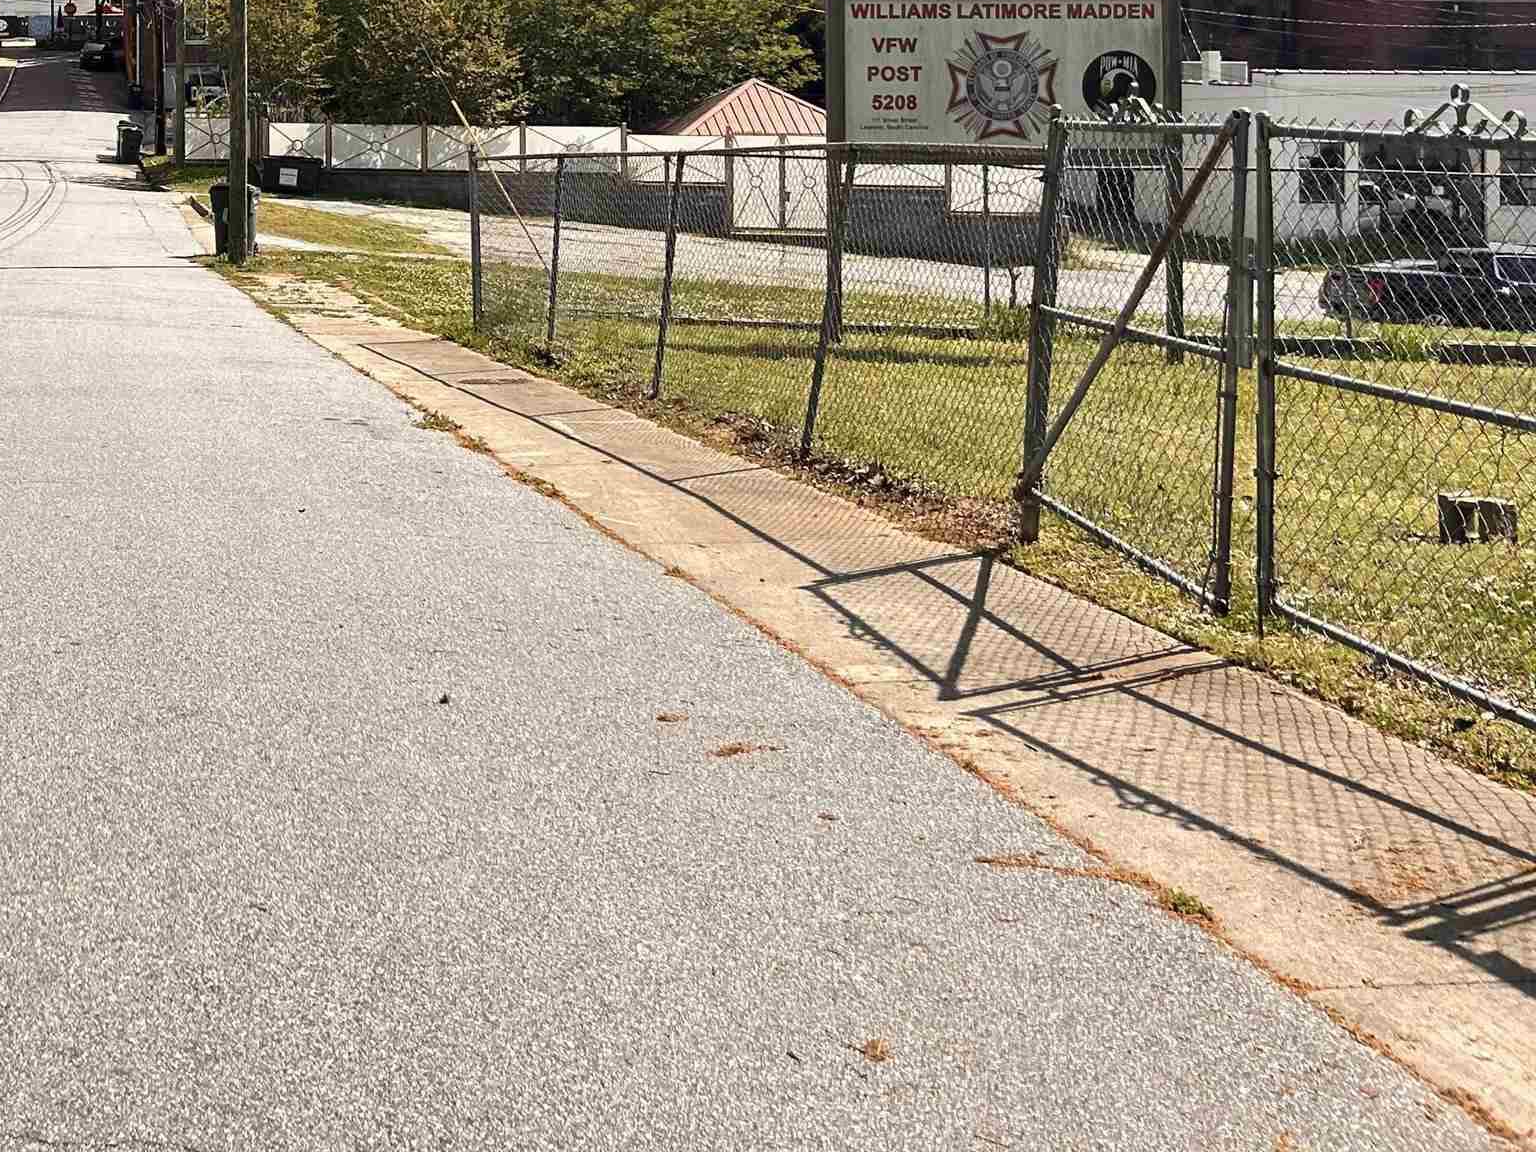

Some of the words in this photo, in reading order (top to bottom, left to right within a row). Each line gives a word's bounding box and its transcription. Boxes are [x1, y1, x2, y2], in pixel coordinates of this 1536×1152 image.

[850, 3, 952, 19] WILLIAMS
[957, 3, 1062, 19] LATIMORE
[1066, 3, 1155, 19] MADDEN
[872, 37, 918, 53] VFW
[867, 66, 922, 81] POST
[871, 94, 917, 110] 5208
